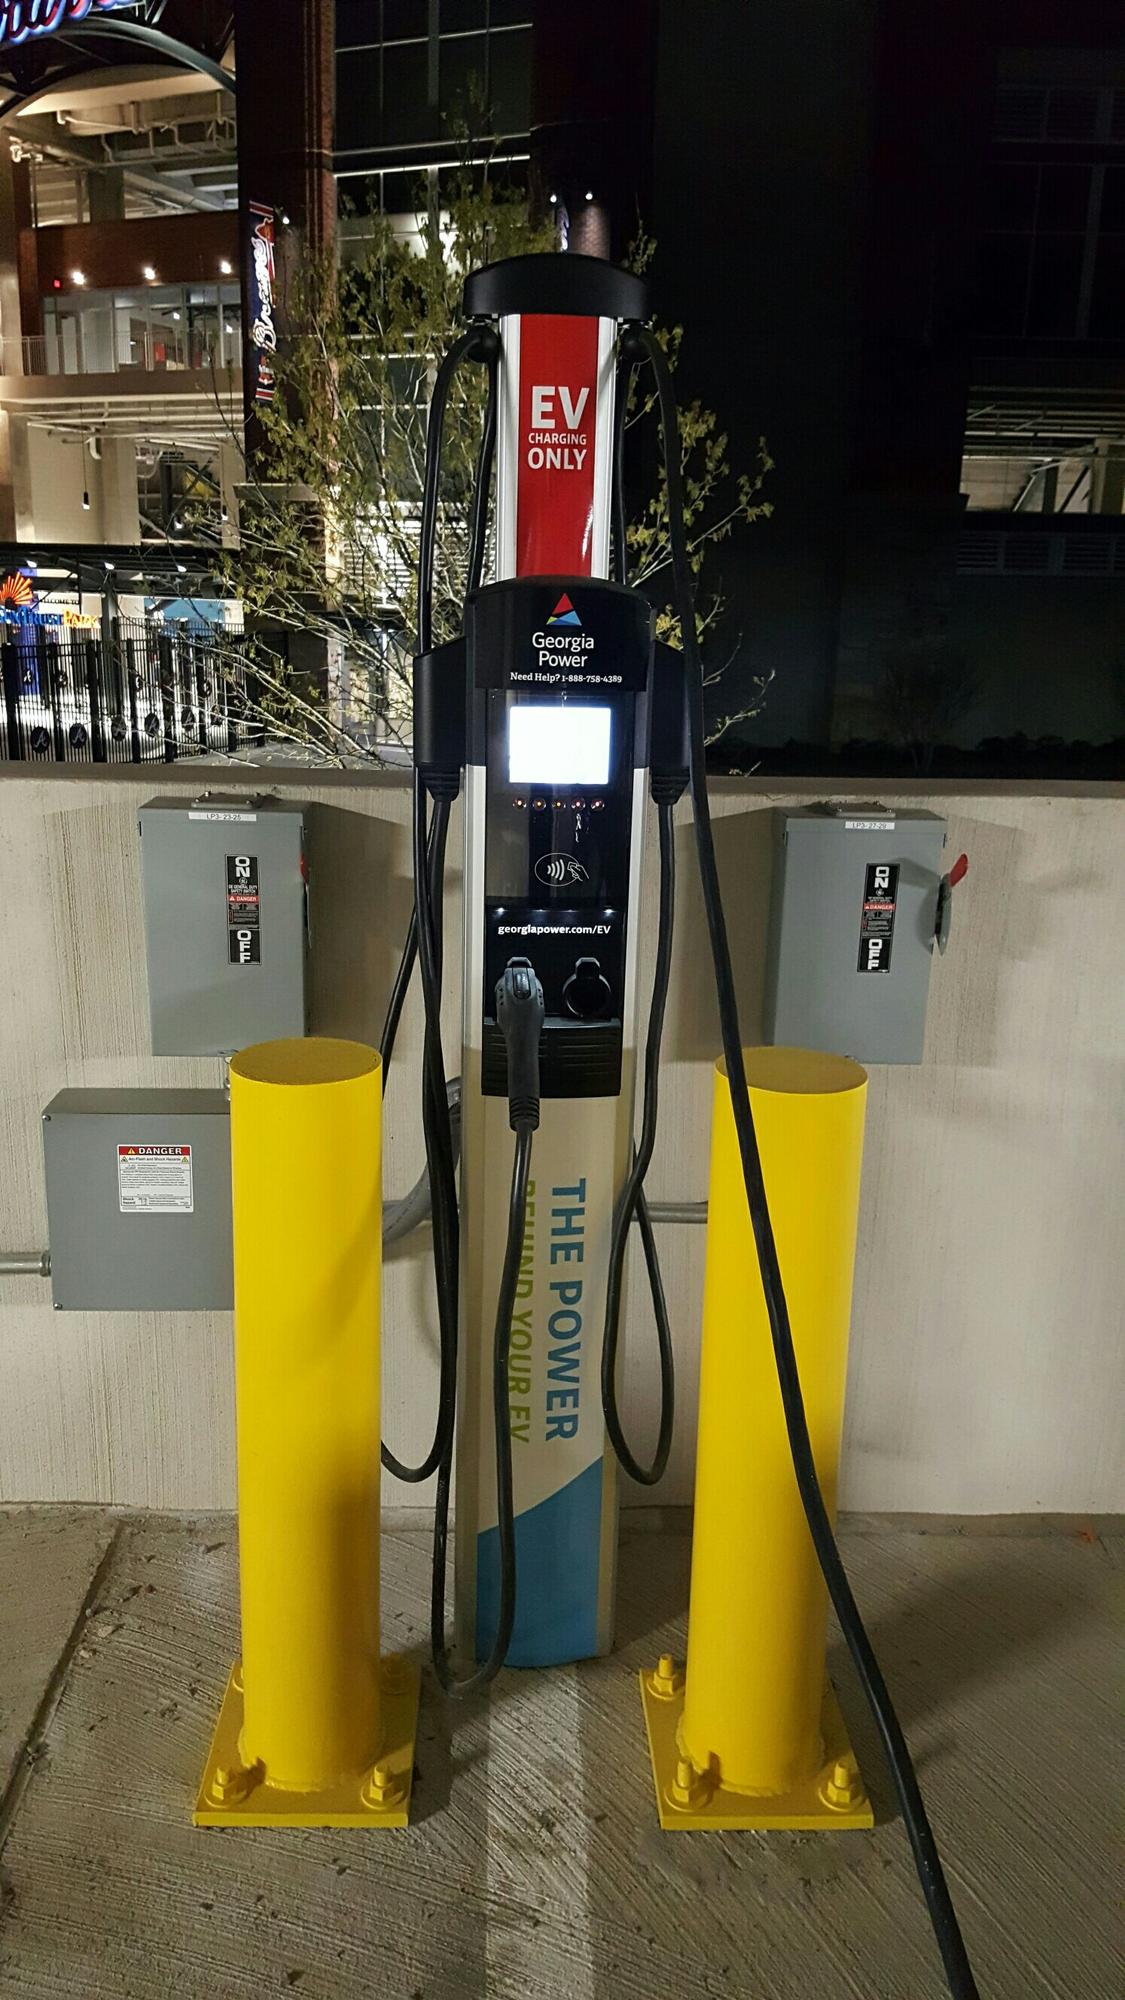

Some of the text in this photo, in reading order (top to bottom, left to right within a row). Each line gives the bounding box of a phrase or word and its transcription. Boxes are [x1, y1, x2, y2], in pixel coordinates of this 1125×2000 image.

[531, 385, 590, 430] EV
[528, 432, 587, 446] CHARGING
[527, 447, 587, 470] ONLY
[532, 632, 595, 657] Georgia
[538, 651, 588, 668] Power
[510, 671, 623, 685] Need Help? 1-888-758-4389
[235, 856, 250, 878] ON
[874, 866, 889, 888] ON
[497, 924, 611, 936] georgiapower.com/EV
[237, 930, 252, 963] OFF
[867, 939, 883, 970] OFF
[138, 1147, 183, 1155] DANGER
[545, 1178, 586, 1442] THE POWER
[508, 1309, 534, 1396] YOUR
[509, 1405, 532, 1444] EV
